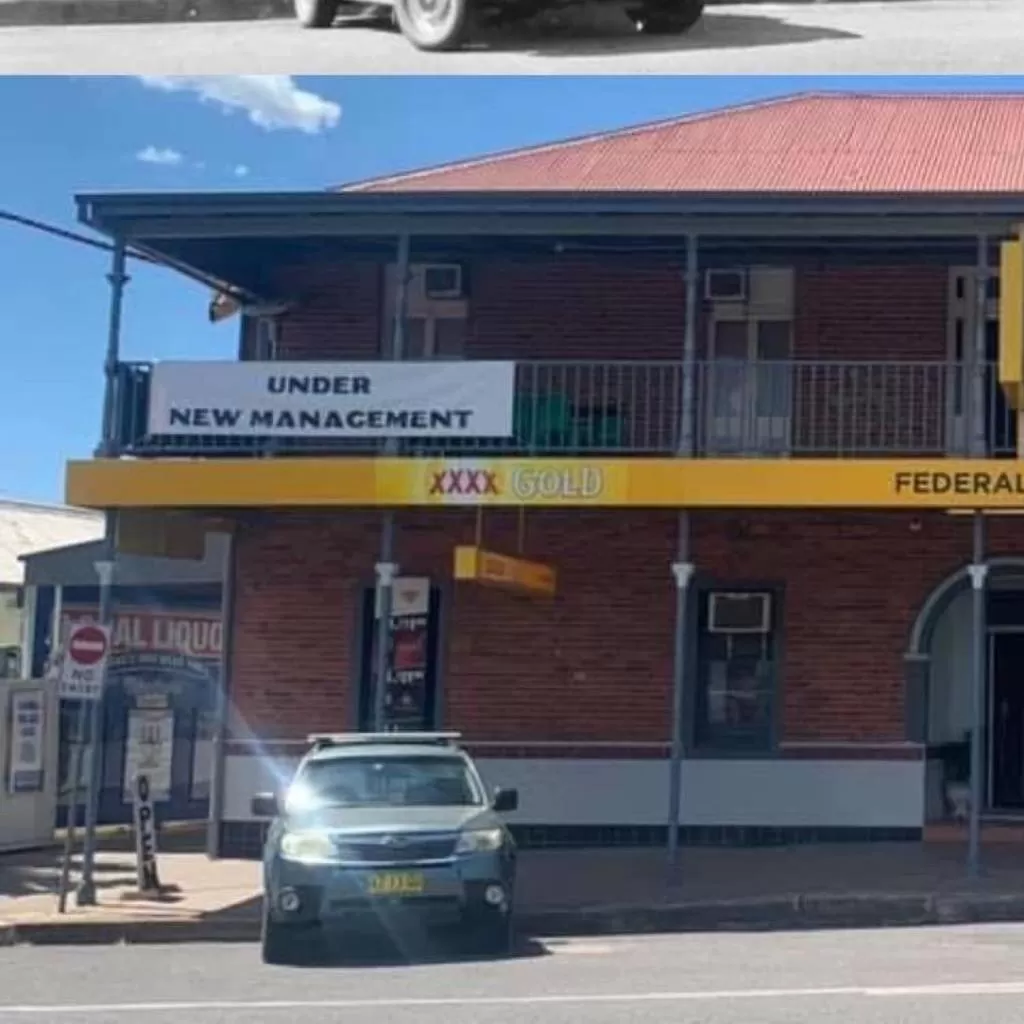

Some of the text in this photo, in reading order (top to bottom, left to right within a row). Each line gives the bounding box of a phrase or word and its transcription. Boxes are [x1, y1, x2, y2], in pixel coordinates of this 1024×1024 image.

[267, 376, 371, 395] UNDER
[169, 407, 474, 429] NEW MANAGEMENT
[429, 466, 605, 501] XXXX GOLD
